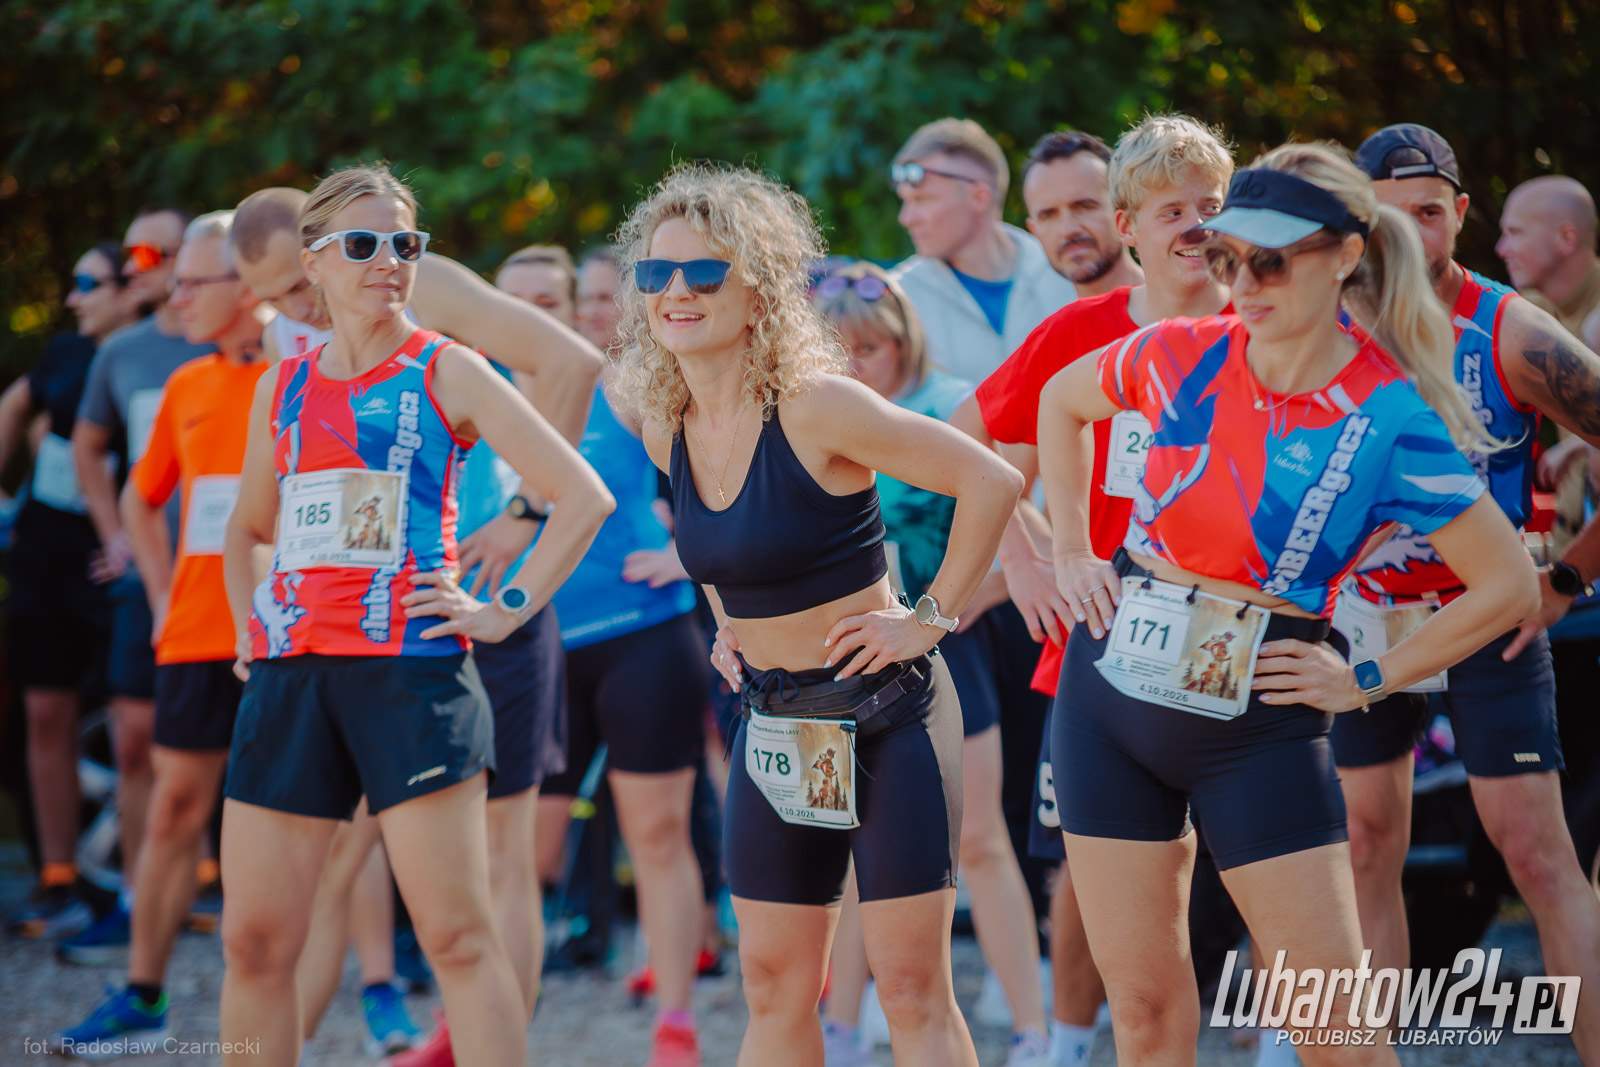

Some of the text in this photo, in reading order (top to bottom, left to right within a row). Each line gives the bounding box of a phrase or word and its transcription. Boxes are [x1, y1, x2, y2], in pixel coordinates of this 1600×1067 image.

[295, 502, 332, 528] 185
[1130, 617, 1171, 650] 171
[753, 747, 791, 776] 178
